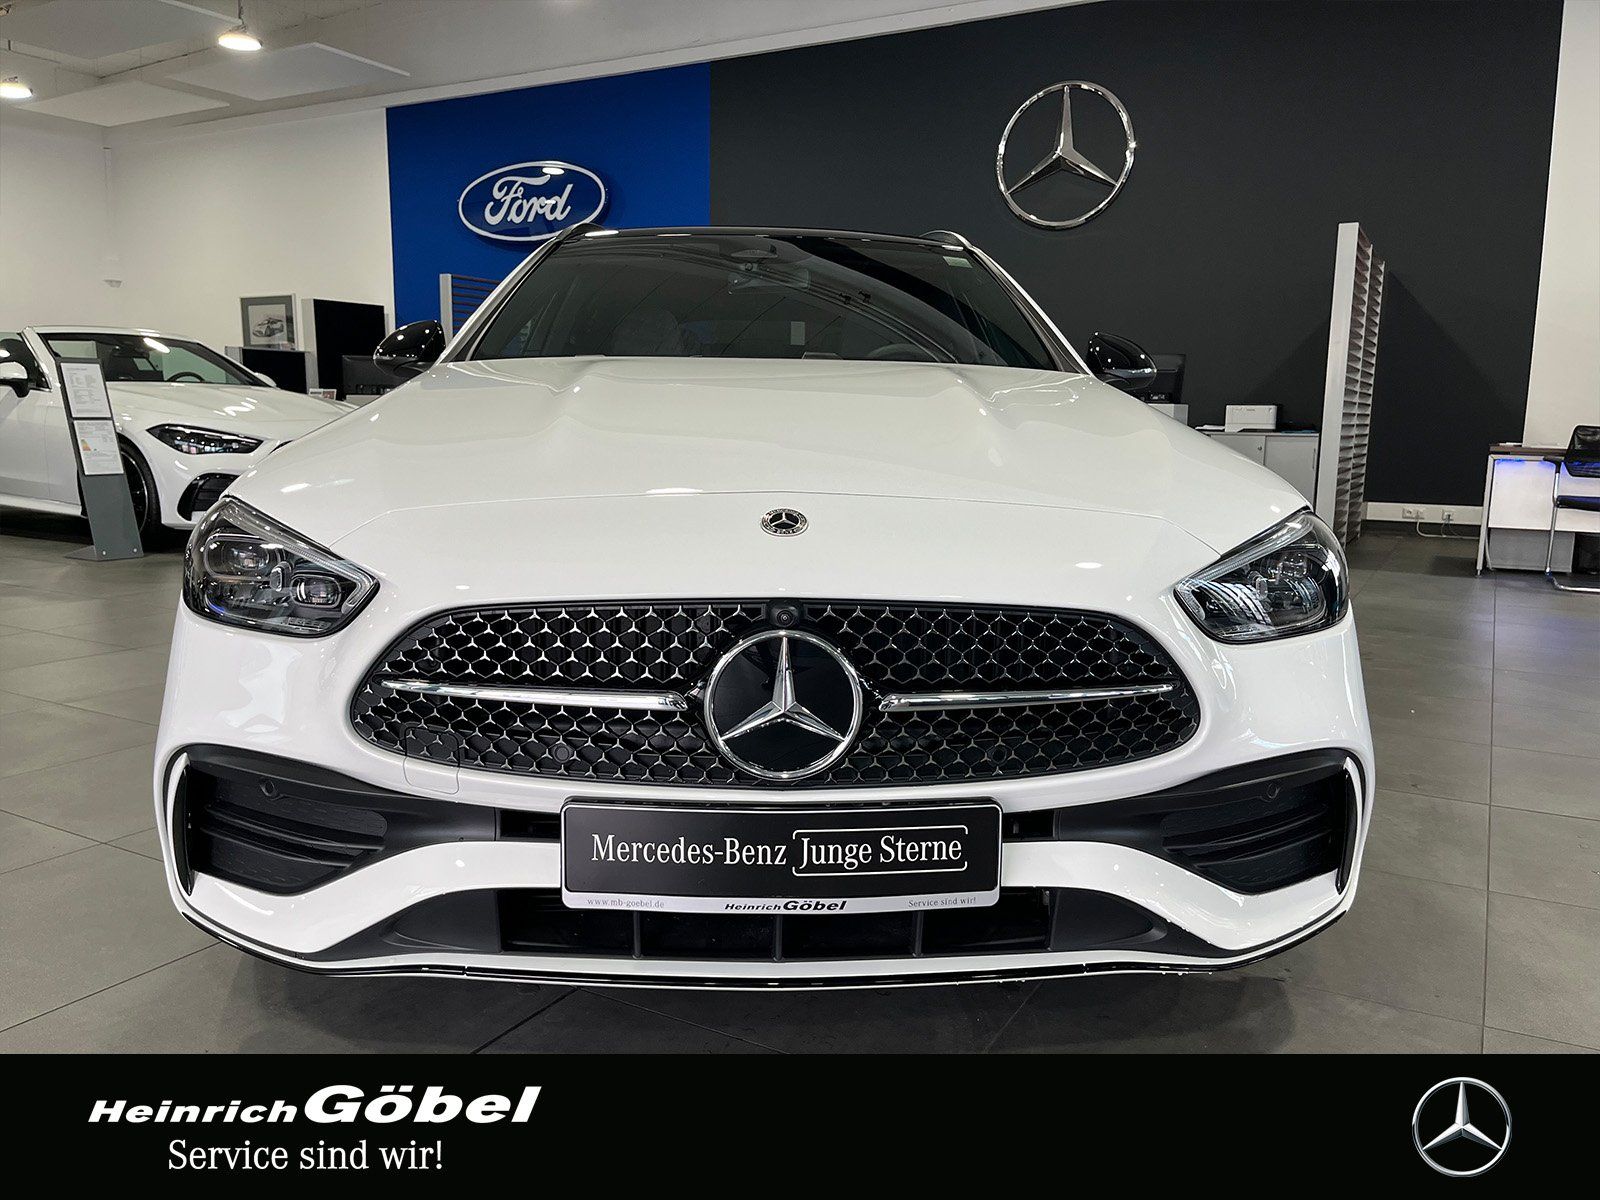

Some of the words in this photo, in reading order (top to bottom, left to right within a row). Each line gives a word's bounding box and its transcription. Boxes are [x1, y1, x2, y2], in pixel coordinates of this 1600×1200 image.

[484, 174, 573, 226] Ford
[591, 833, 787, 865] Mercedes-Benz
[799, 837, 872, 870] Junge
[879, 835, 962, 863] Sterne
[587, 898, 664, 908] www.mb-goebel.de
[908, 899, 939, 907] Service
[940, 897, 958, 905] sind
[960, 896, 976, 904] wir!
